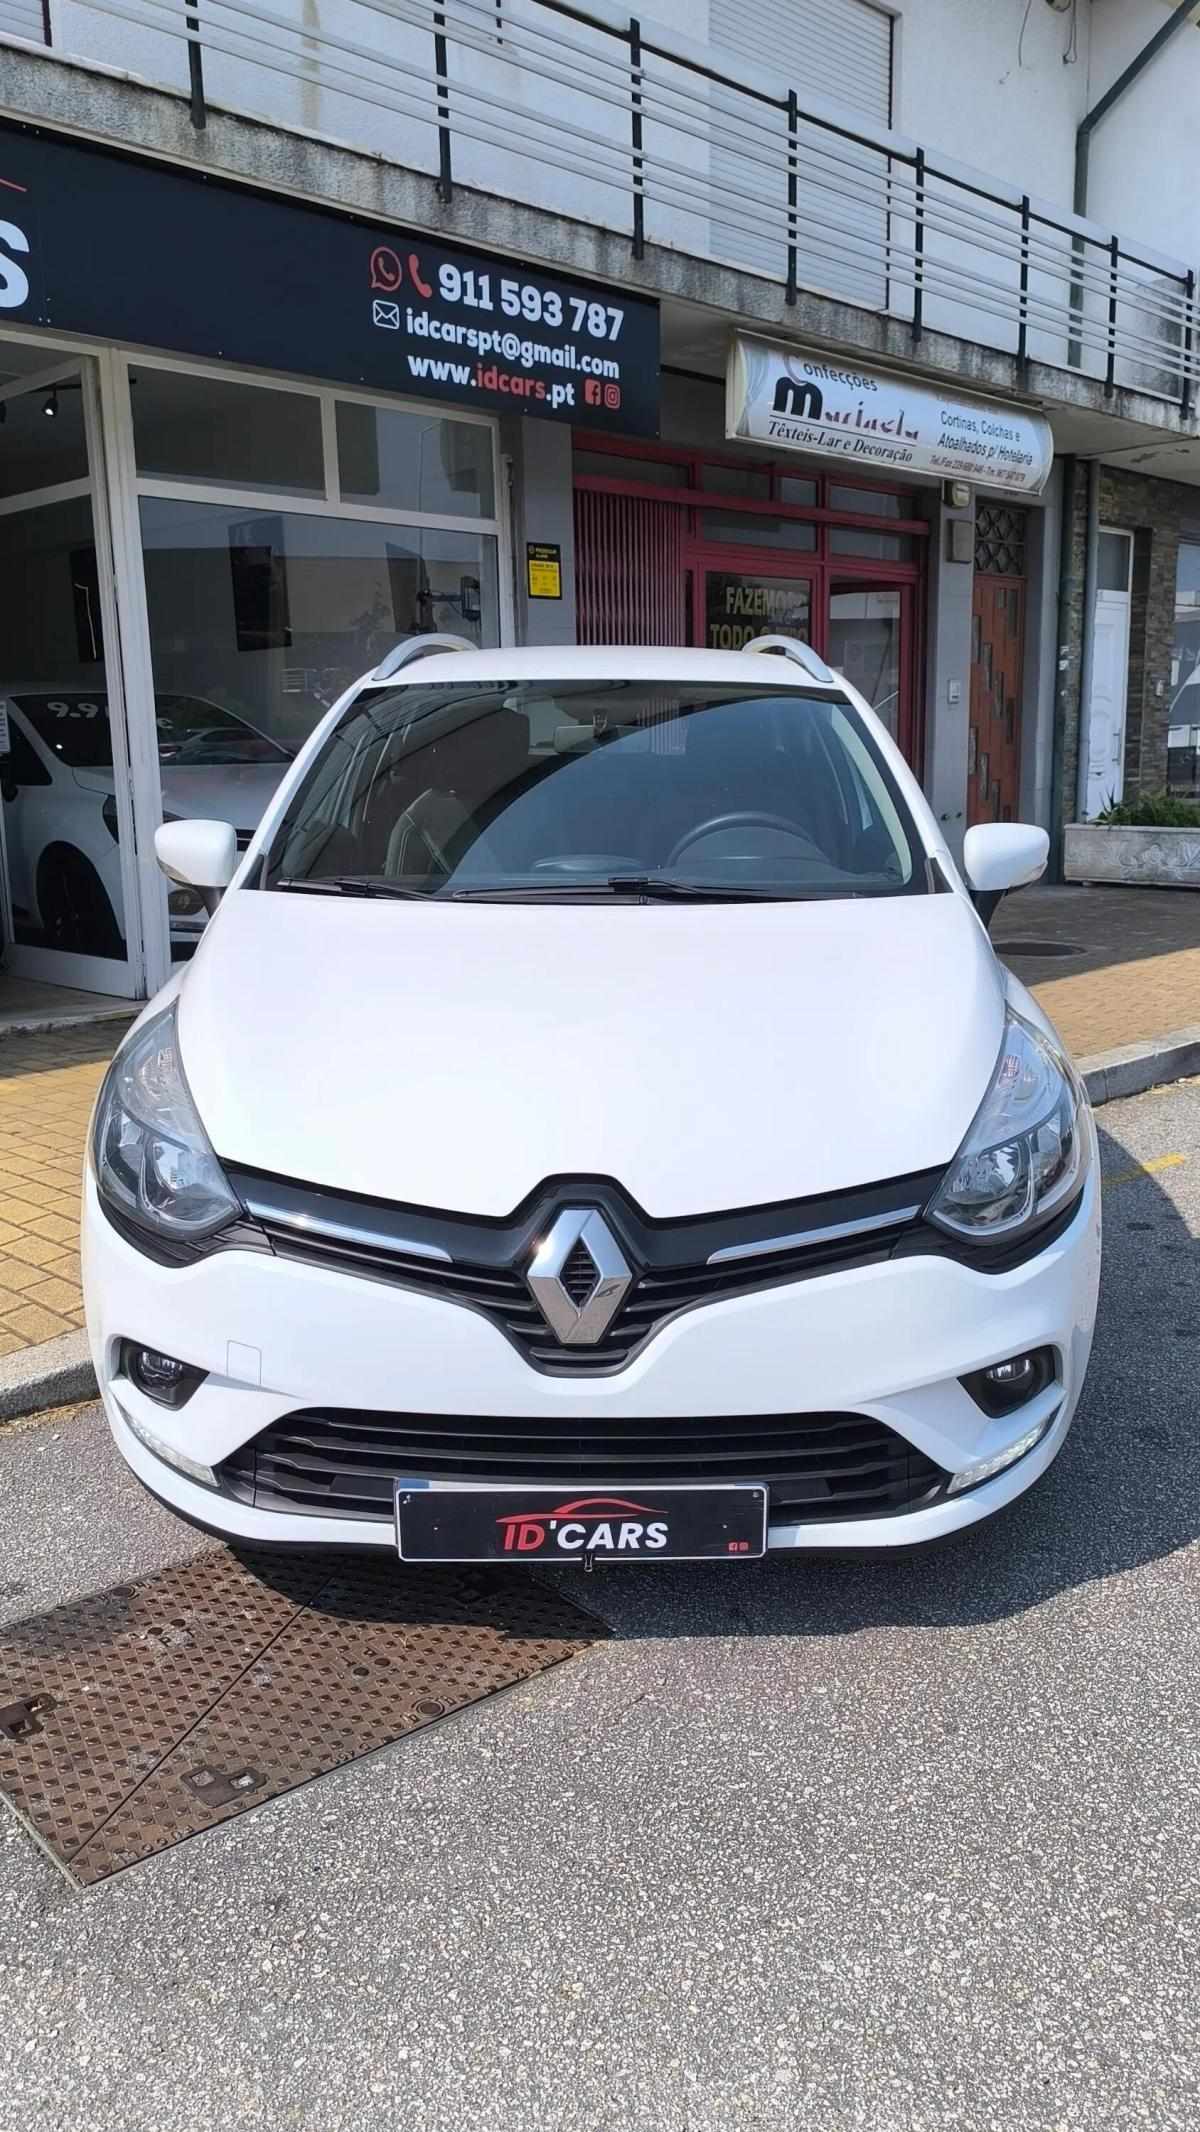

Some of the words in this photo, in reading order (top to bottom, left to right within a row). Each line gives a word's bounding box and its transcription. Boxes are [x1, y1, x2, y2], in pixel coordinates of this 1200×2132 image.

[438, 263, 494, 311] 911
[500, 278, 563, 328] 593
[569, 296, 625, 341] 787
[406, 307, 620, 379] idcarspt@gmail.com
[407, 355, 575, 409] www.idcars.pt
[843, 440, 852, 449] e
[853, 437, 913, 463] Decoração
[725, 586, 794, 619] FAZEMO
